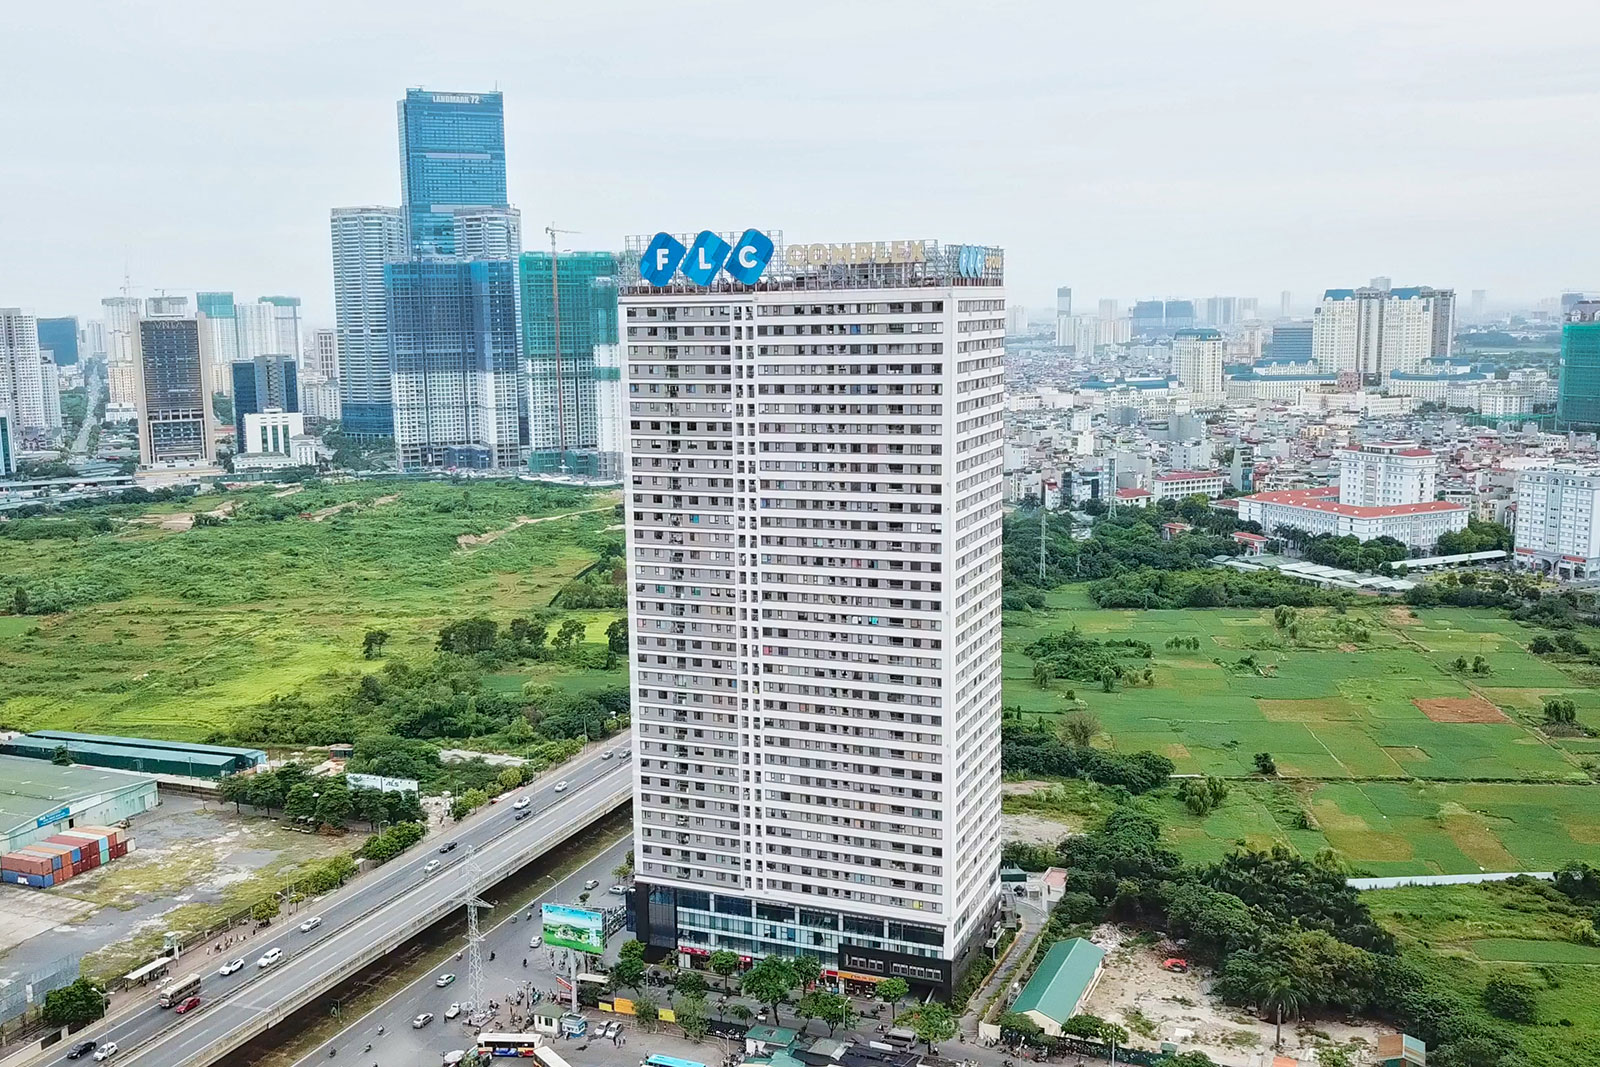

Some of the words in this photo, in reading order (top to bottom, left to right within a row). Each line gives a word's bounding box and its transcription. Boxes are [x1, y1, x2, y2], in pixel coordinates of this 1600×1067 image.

[432, 95, 469, 103] LANDMARK
[470, 95, 480, 104] 72
[786, 240, 926, 267] COMPLEX
